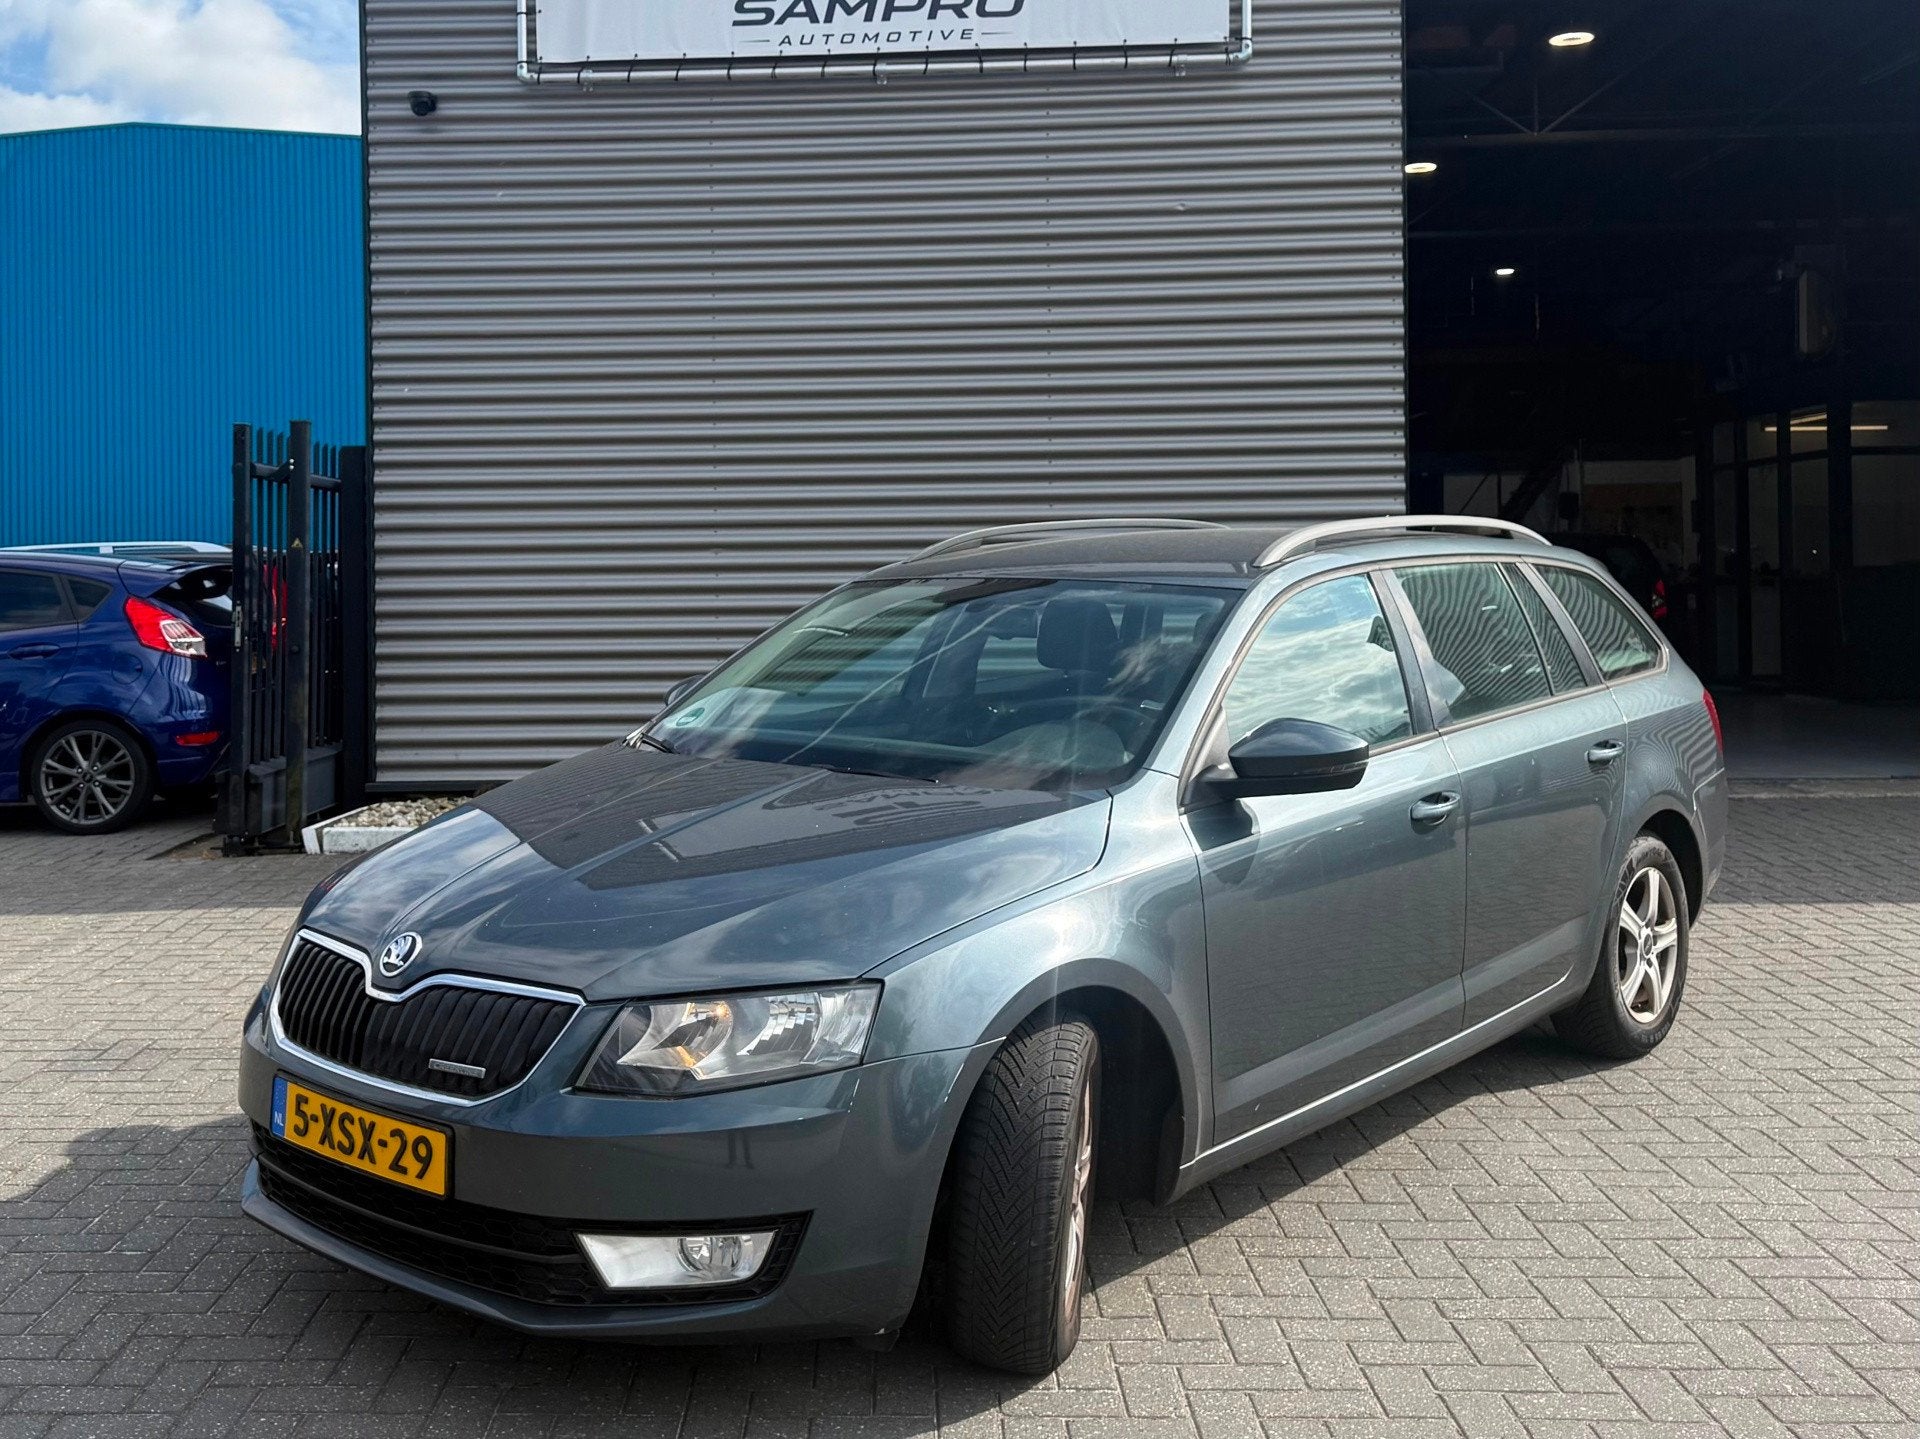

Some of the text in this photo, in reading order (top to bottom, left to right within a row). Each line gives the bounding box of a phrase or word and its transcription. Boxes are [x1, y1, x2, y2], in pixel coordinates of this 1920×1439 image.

[778, 28, 975, 46] AUTOMOTIVE
[274, 1110, 284, 1127] NL
[293, 1093, 433, 1180] 5-XSX-29
